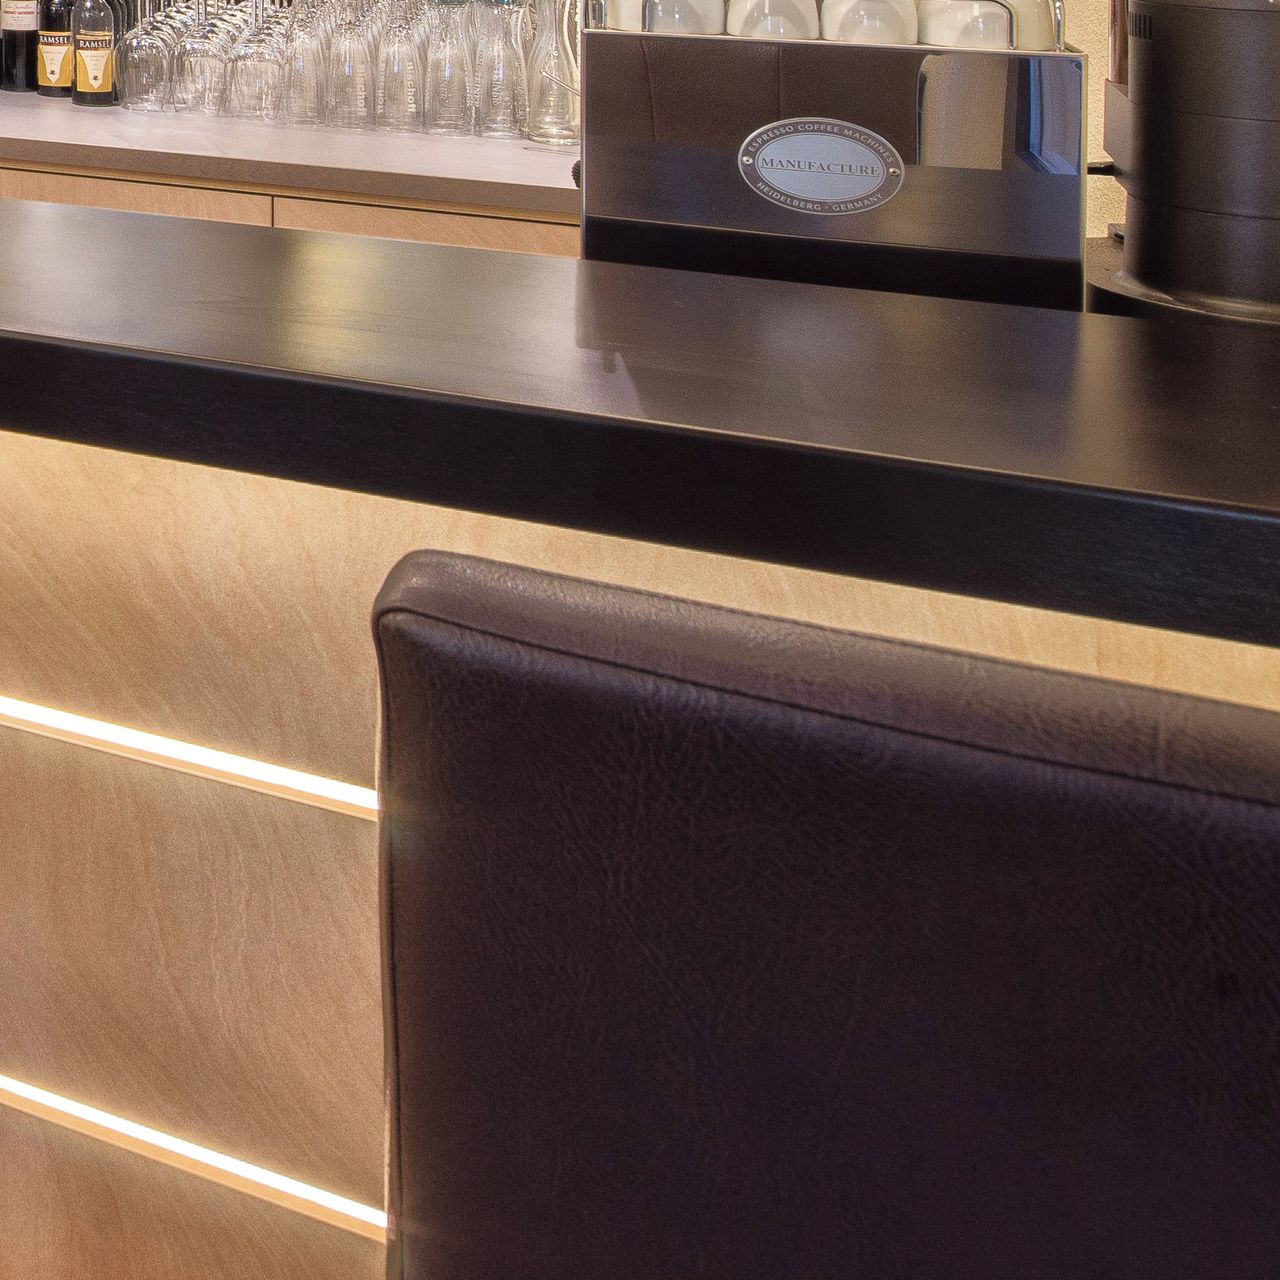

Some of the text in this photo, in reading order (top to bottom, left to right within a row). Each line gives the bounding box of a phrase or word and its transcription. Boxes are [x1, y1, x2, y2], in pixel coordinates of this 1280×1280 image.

[39, 35, 70, 45] RAMSEL
[79, 36, 111, 49] RAMSEL
[748, 122, 895, 163] ESPRESSO COFFEE MACHINES
[761, 157, 880, 176] MANUFACTURE
[756, 181, 883, 212] HEIDELBERG GERMANY
